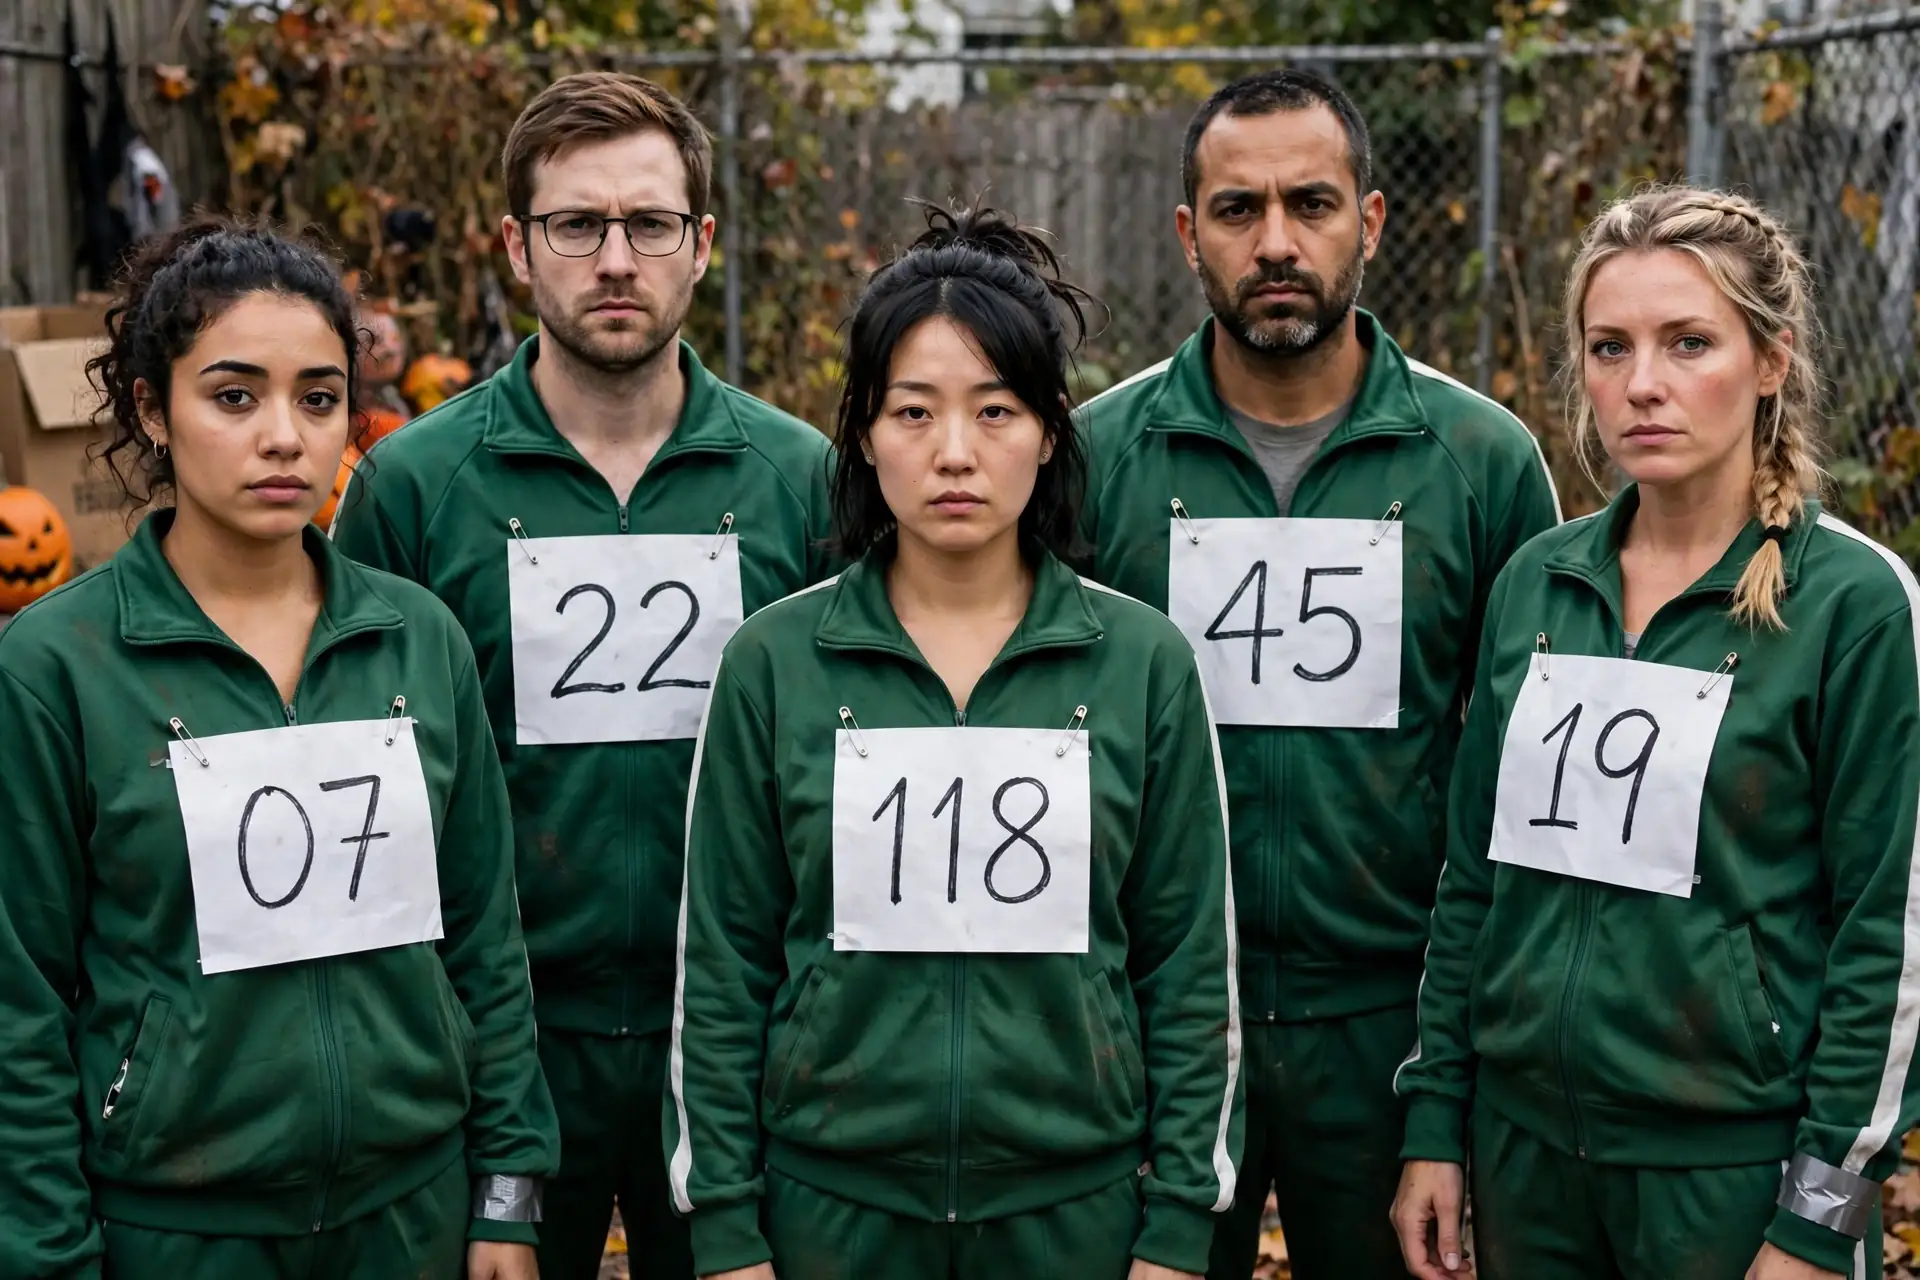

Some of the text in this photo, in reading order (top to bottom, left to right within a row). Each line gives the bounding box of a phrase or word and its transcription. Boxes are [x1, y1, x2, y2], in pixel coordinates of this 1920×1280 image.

[550, 580, 711, 700] 22
[1203, 559, 1363, 685] 45
[1528, 702, 1660, 845] 19
[237, 774, 390, 910] 07
[872, 776, 1052, 906] 118
